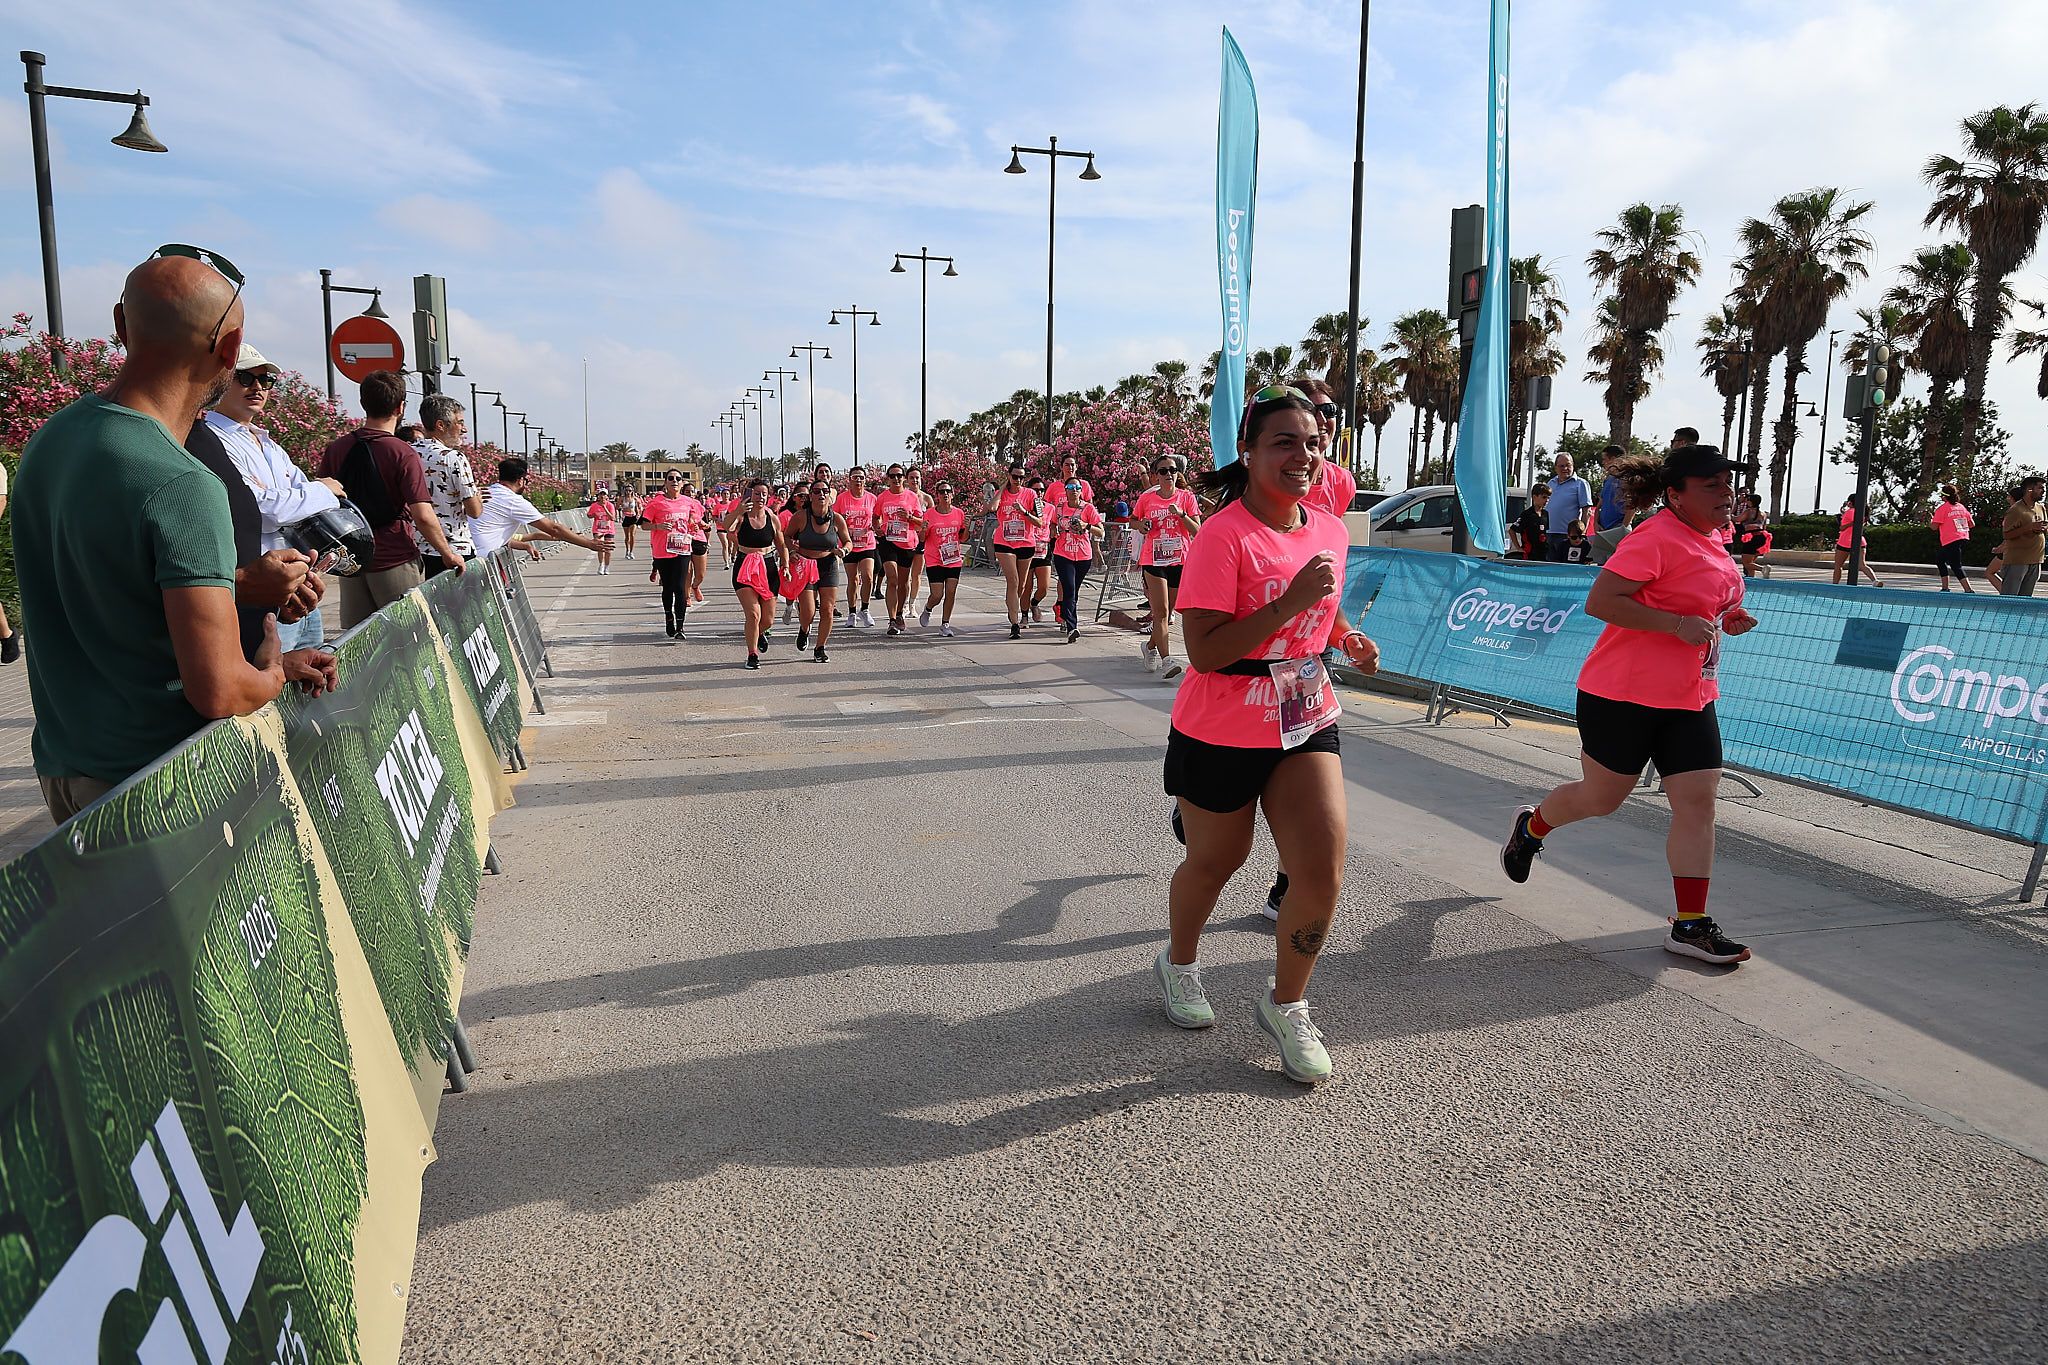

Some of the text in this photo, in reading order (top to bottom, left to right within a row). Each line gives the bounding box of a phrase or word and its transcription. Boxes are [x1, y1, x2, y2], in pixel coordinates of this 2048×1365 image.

[1256, 554, 1293, 569] OYSHO
[1447, 588, 1578, 634] Compeed
[1471, 635, 1512, 650] AMPOLLAS
[1305, 689, 1324, 710] 016
[1960, 735, 2046, 765] AMPOLLAS
[239, 894, 278, 970] 2026
